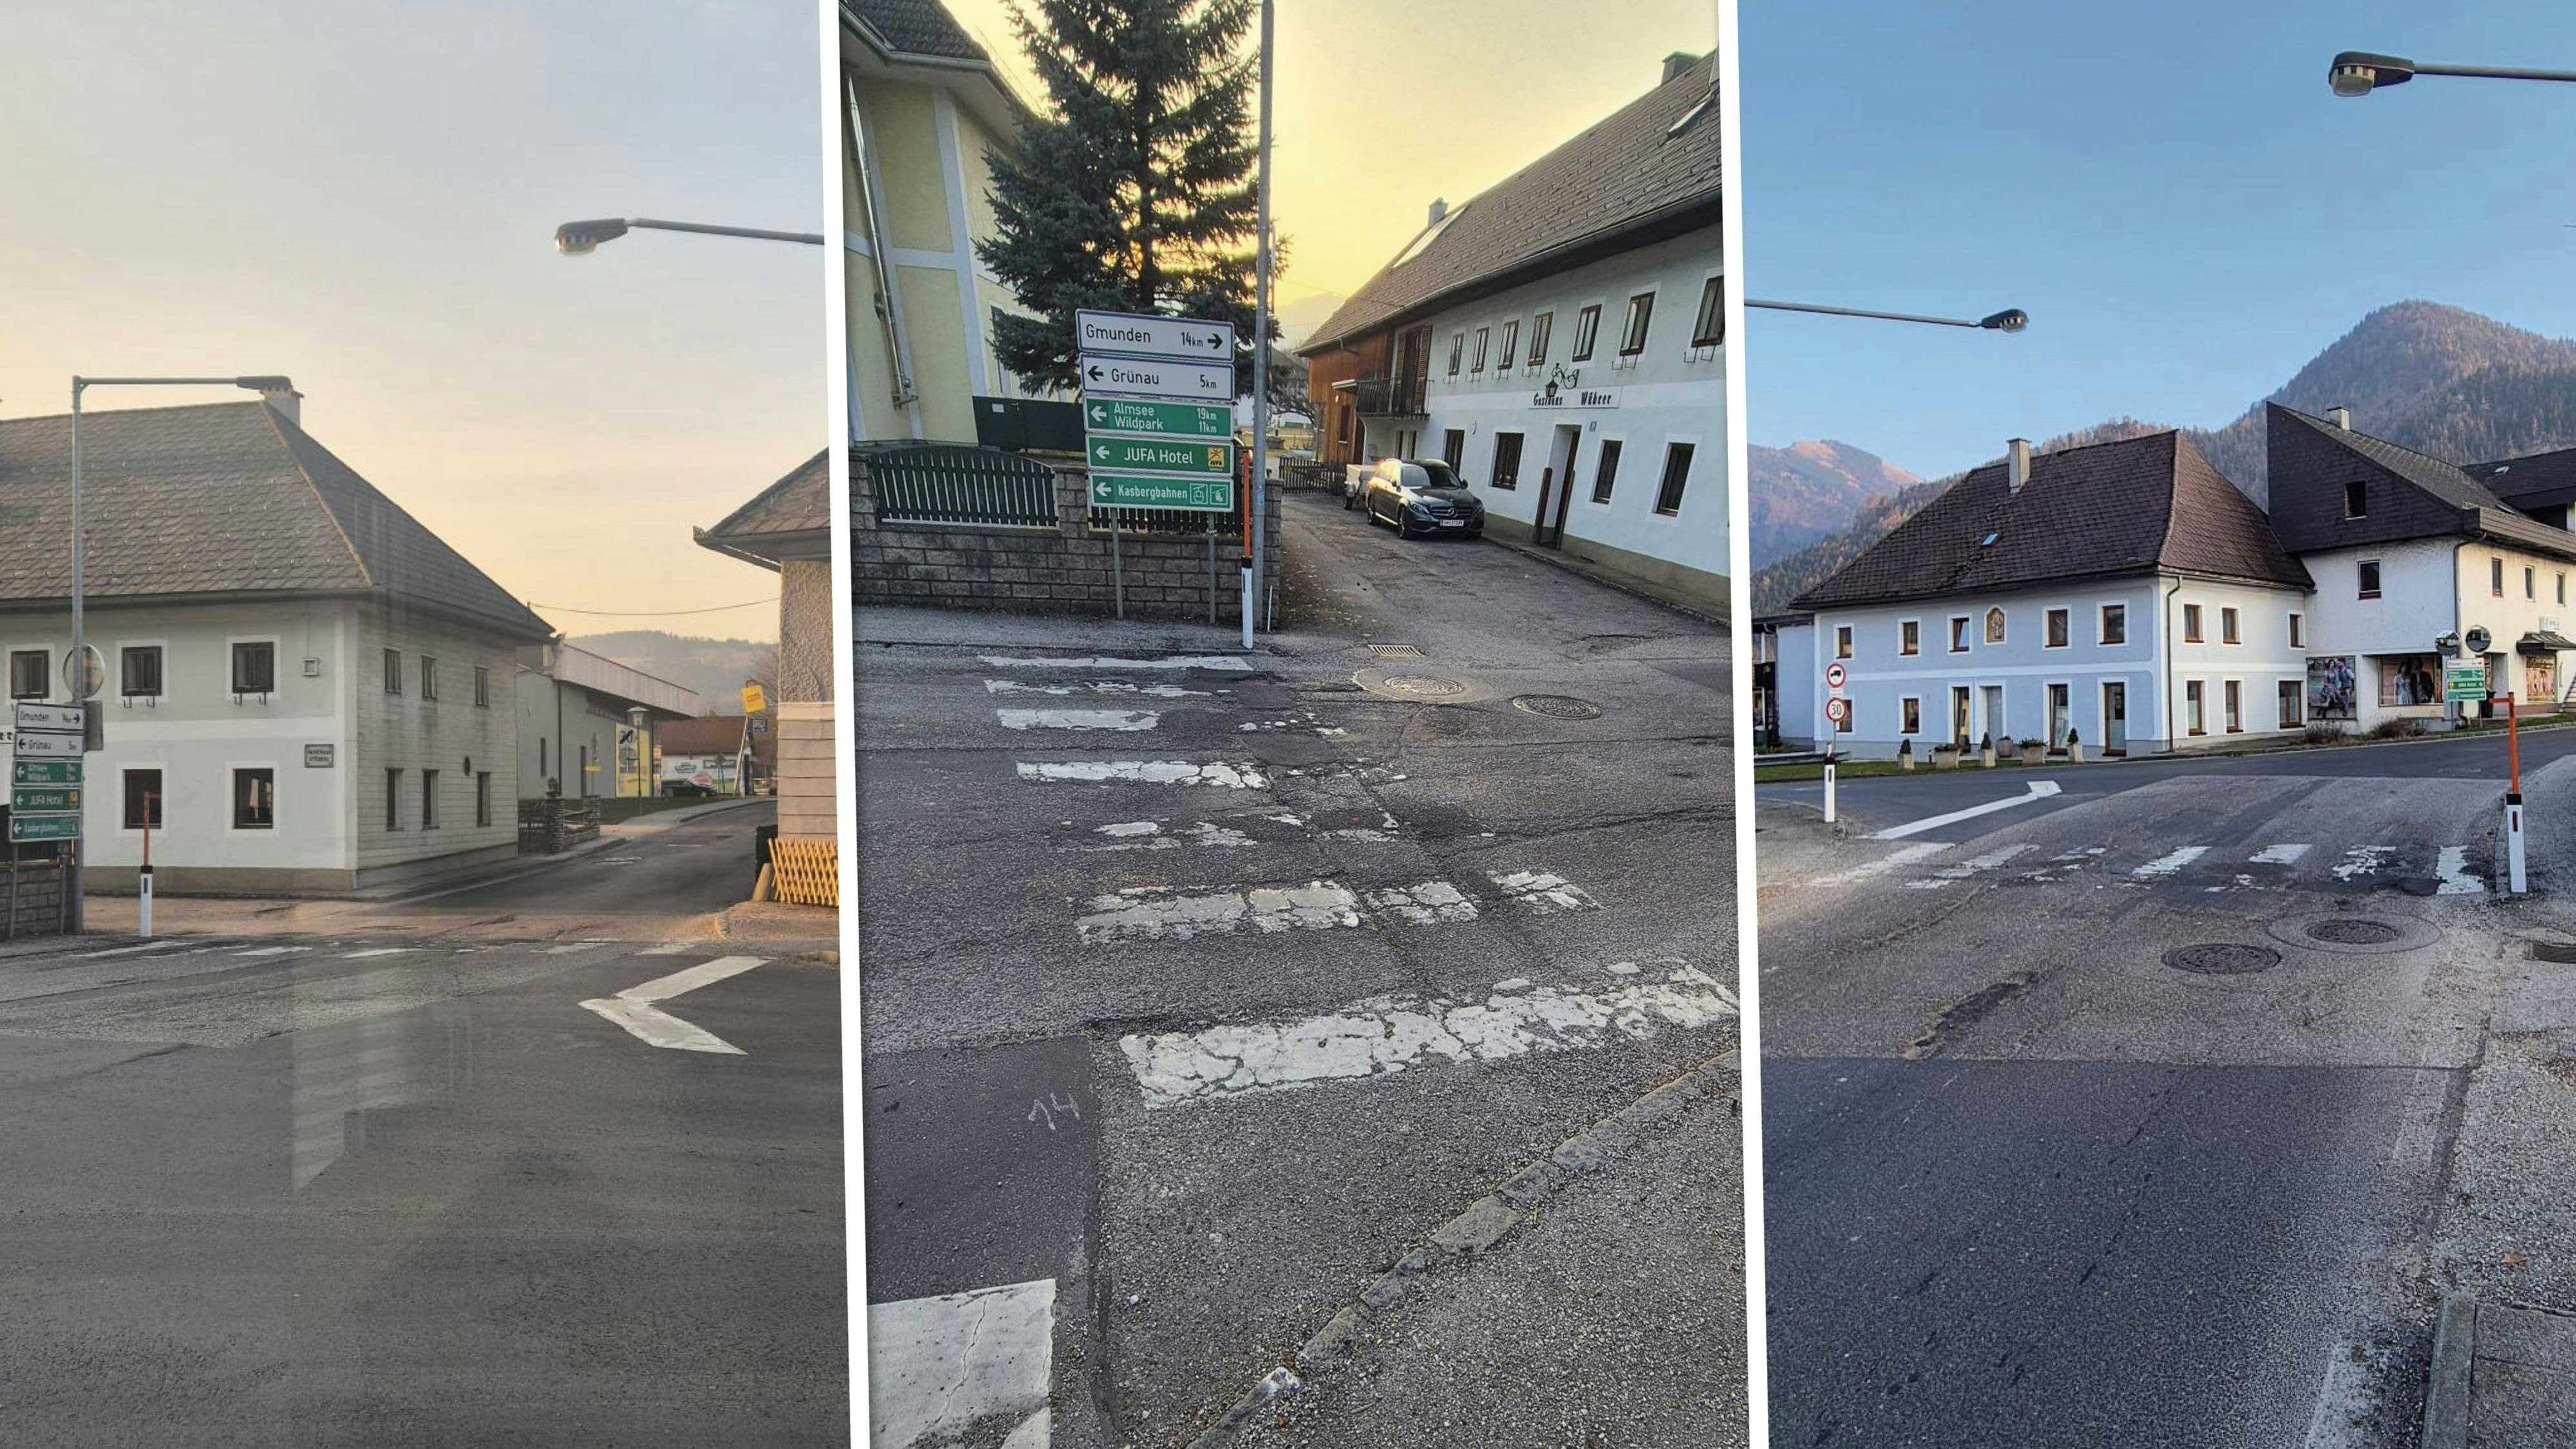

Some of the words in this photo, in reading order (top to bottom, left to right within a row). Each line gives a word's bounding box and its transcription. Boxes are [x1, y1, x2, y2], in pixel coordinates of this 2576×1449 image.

[1086, 324, 1151, 343] Gmunden
[1112, 368, 1159, 385] Grünau
[1113, 402, 1155, 416] Almsee
[1115, 416, 1164, 431] Wildpark
[1124, 447, 1155, 462] JUFA
[1159, 450, 1193, 464] Hotel
[1118, 484, 1188, 500] Kasbergbahnen
[1831, 704, 1842, 715] 30
